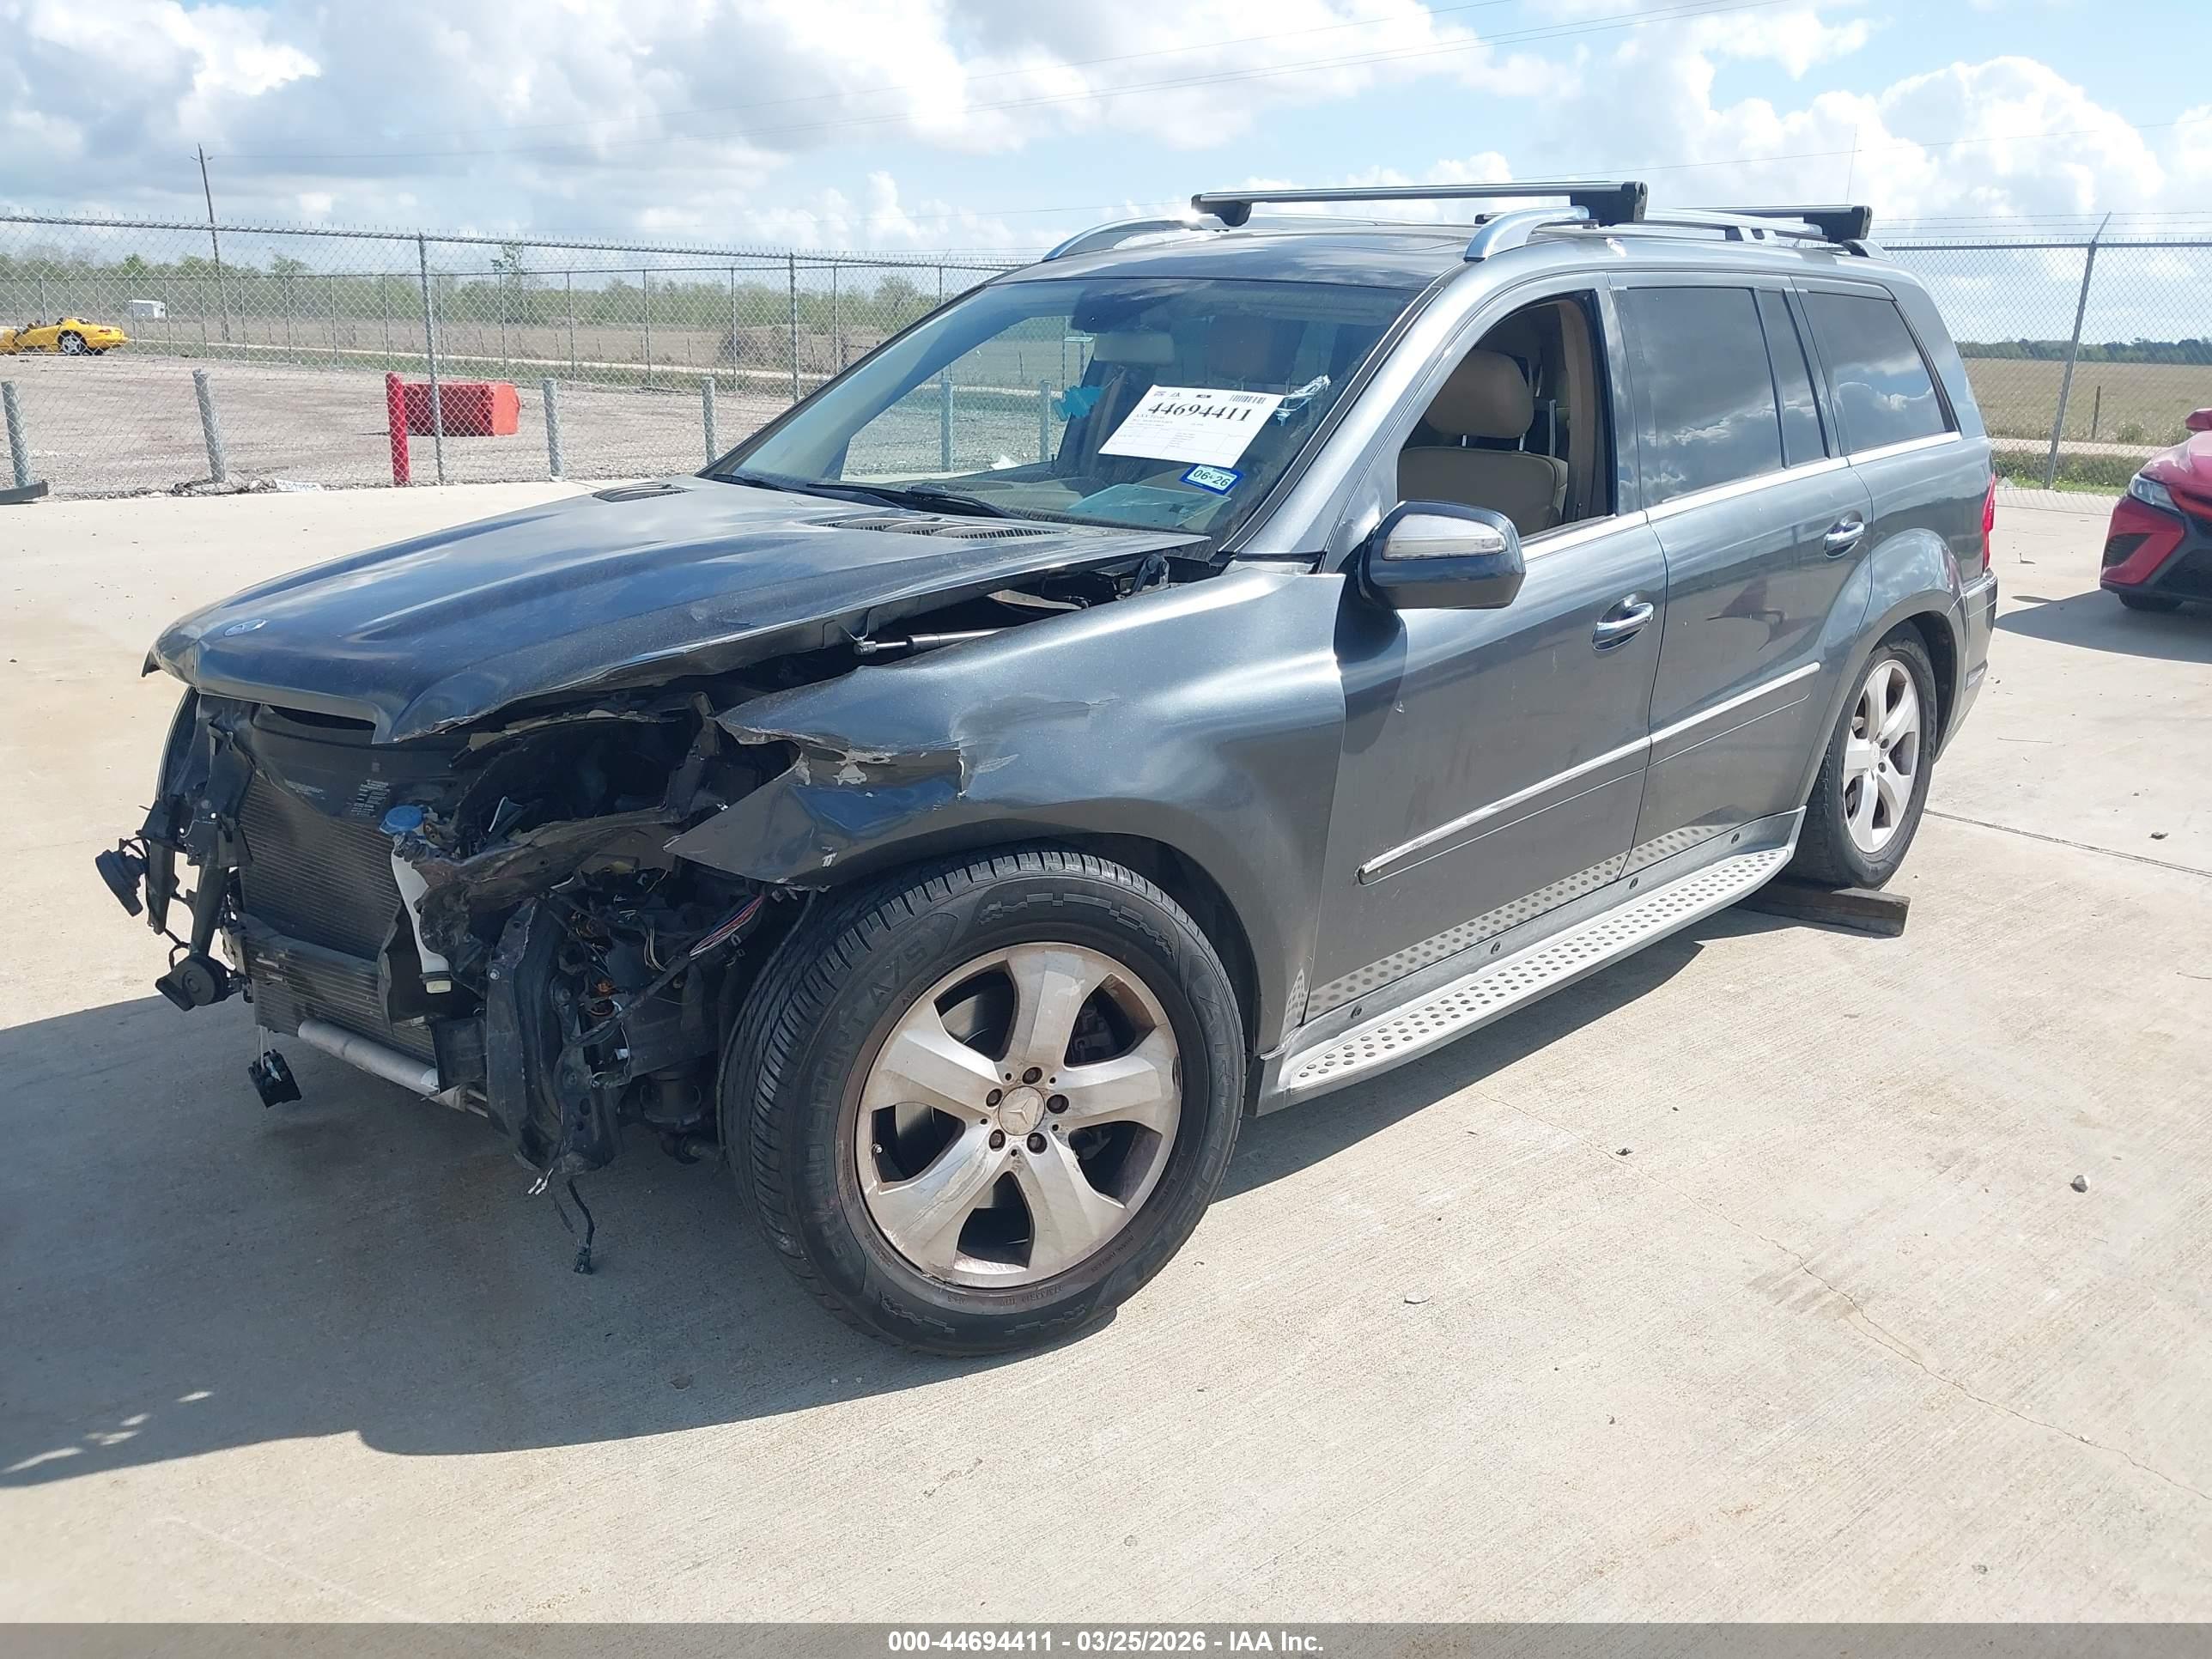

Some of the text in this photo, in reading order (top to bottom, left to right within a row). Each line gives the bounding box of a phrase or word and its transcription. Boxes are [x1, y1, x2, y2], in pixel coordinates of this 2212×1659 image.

[1148, 402, 1253, 422] 44694411
[1193, 469, 1211, 480] 06
[1212, 476, 1231, 487] 26
